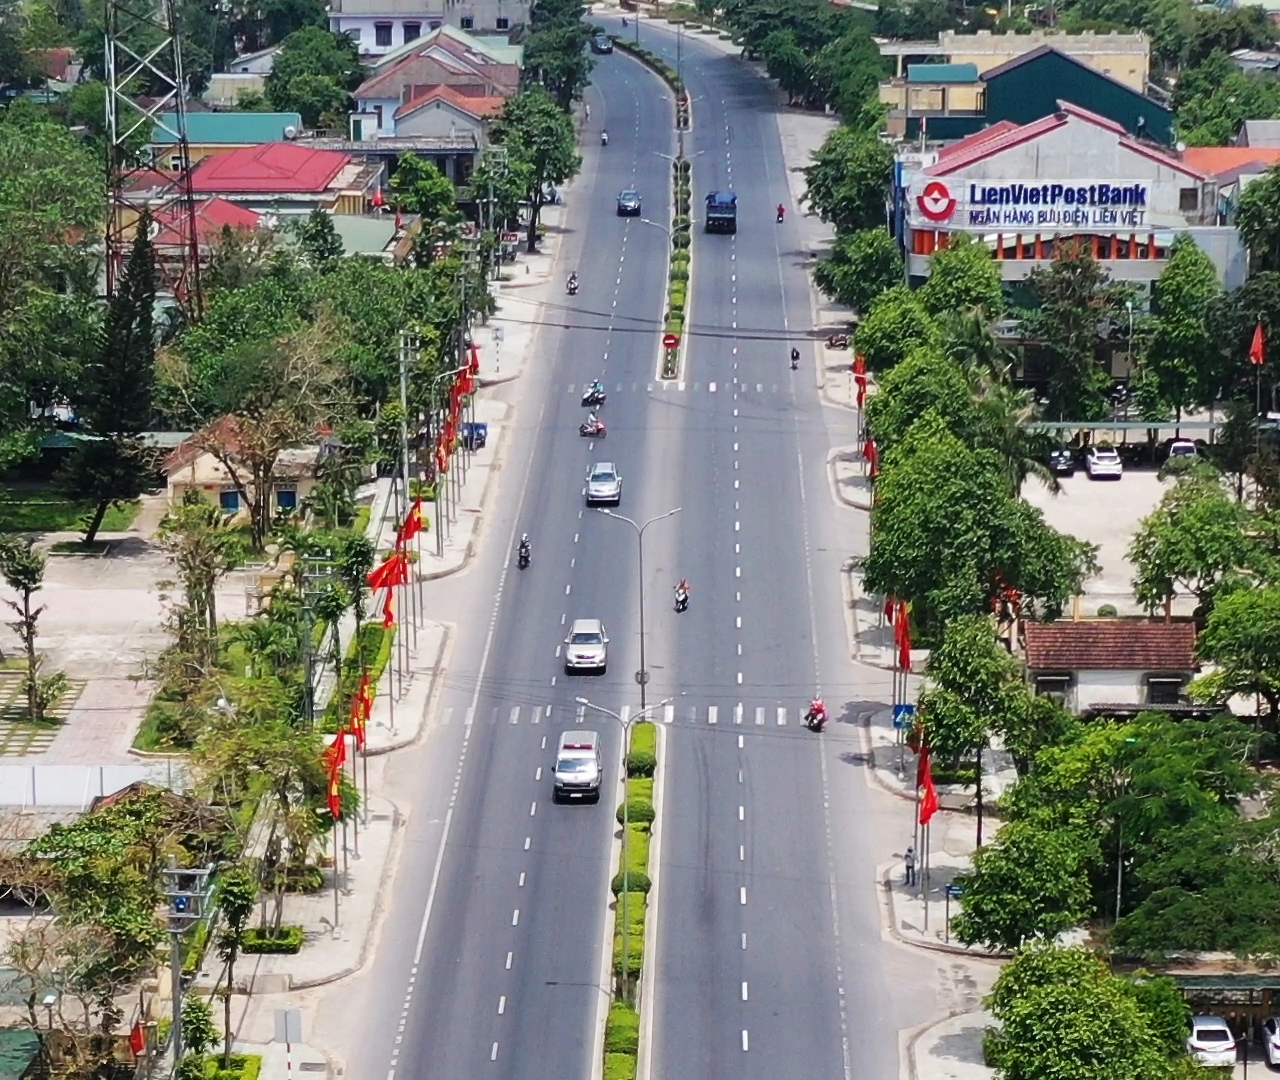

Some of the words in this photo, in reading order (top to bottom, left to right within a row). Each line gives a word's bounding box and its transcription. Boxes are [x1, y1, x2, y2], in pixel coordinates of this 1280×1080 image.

[970, 184, 1146, 206] LienVietPostBank
[969, 207, 1000, 225] NGÂN
[1003, 207, 1034, 224] HÀNG
[1120, 207, 1145, 227] VIỆT
